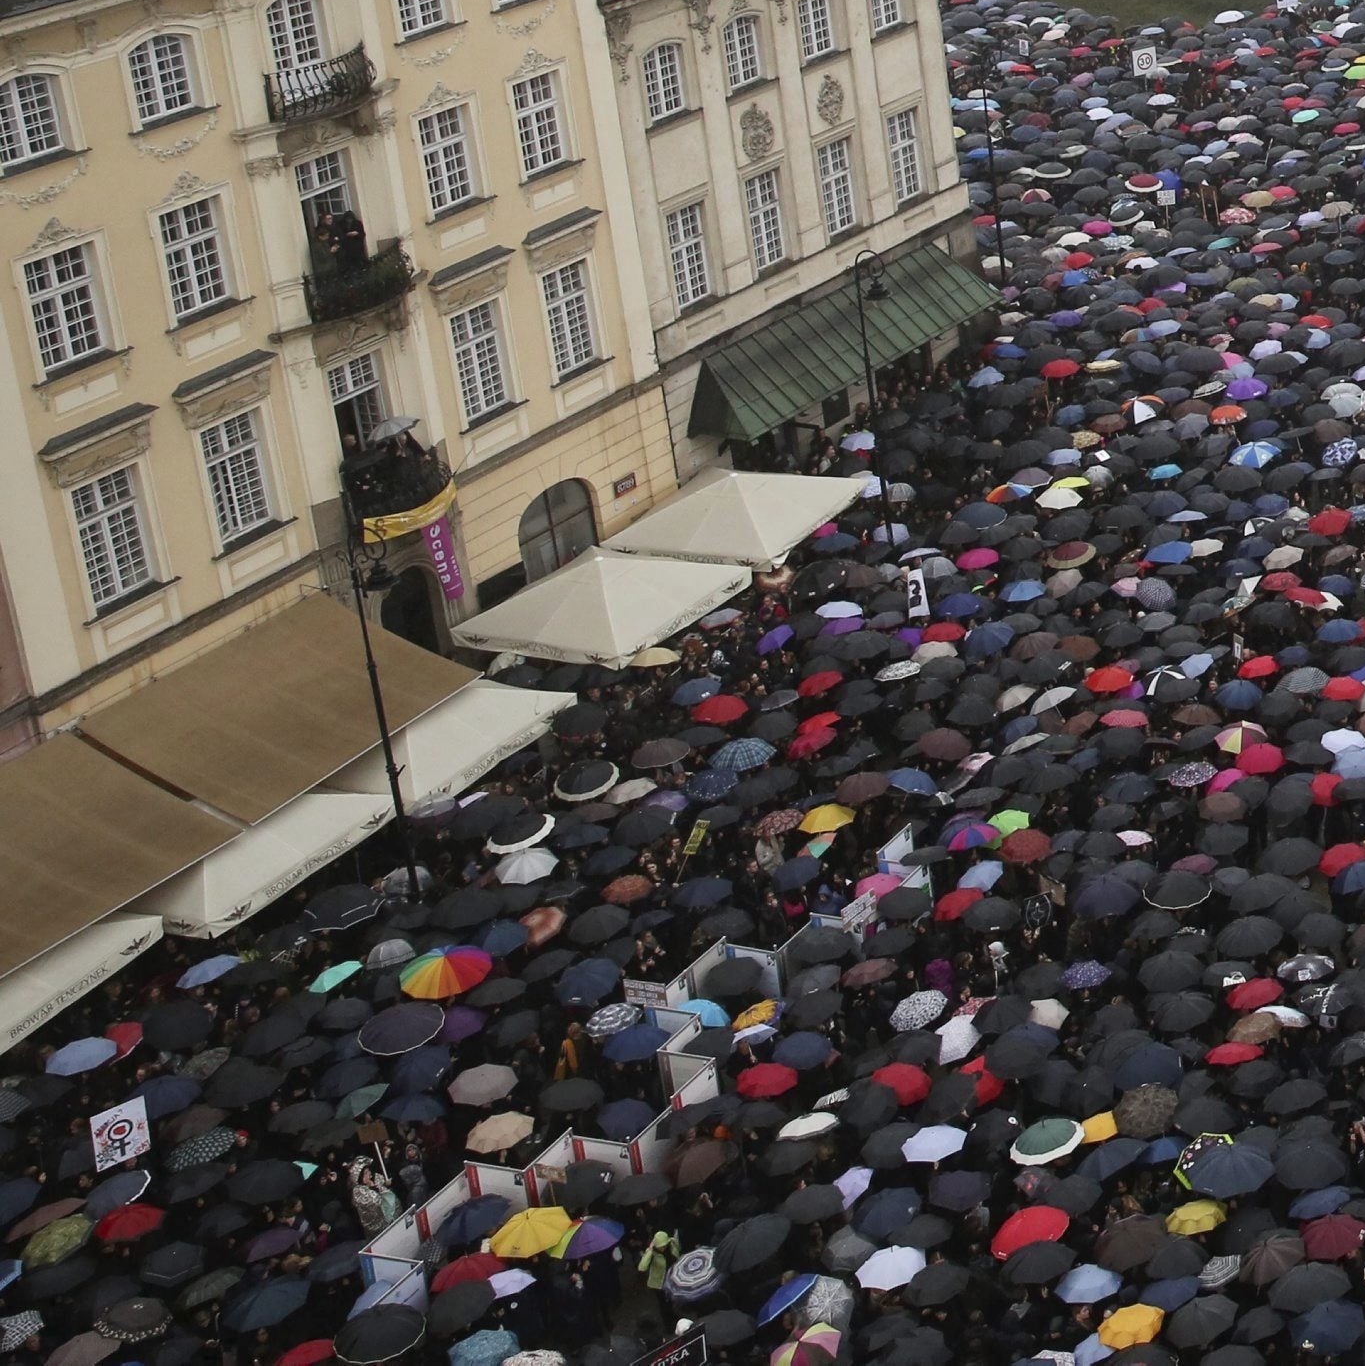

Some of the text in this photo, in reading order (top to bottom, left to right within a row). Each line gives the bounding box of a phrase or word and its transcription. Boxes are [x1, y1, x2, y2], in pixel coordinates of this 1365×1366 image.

[1140, 57, 1151, 66] 30
[429, 524, 451, 584] Scena
[463, 755, 496, 781] BROWAR
[265, 836, 352, 898] BROWAR TENCZYNEK
[9, 964, 108, 1039] BROWAR TENCZYNEK
